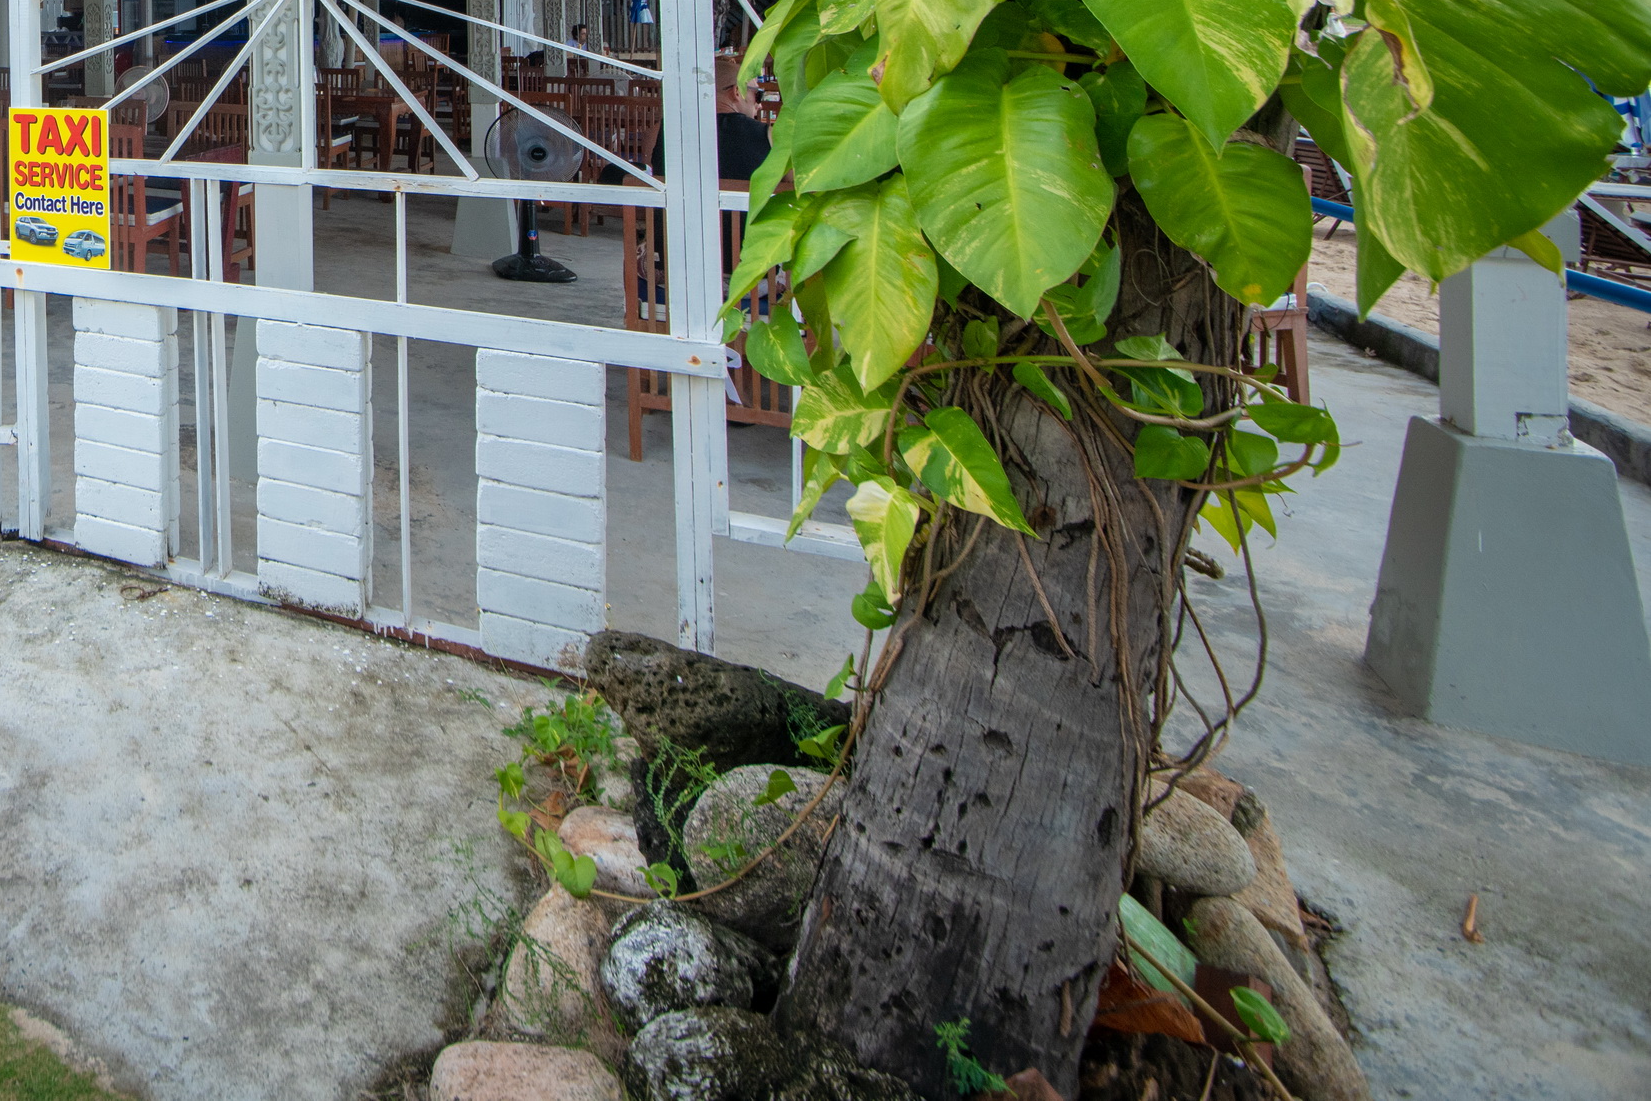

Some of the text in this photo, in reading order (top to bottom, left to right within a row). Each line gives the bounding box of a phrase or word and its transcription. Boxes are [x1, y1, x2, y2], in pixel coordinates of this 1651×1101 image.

[13, 114, 101, 157] TAXI
[14, 160, 103, 190] SERVICE
[15, 192, 104, 215] Contact Here
